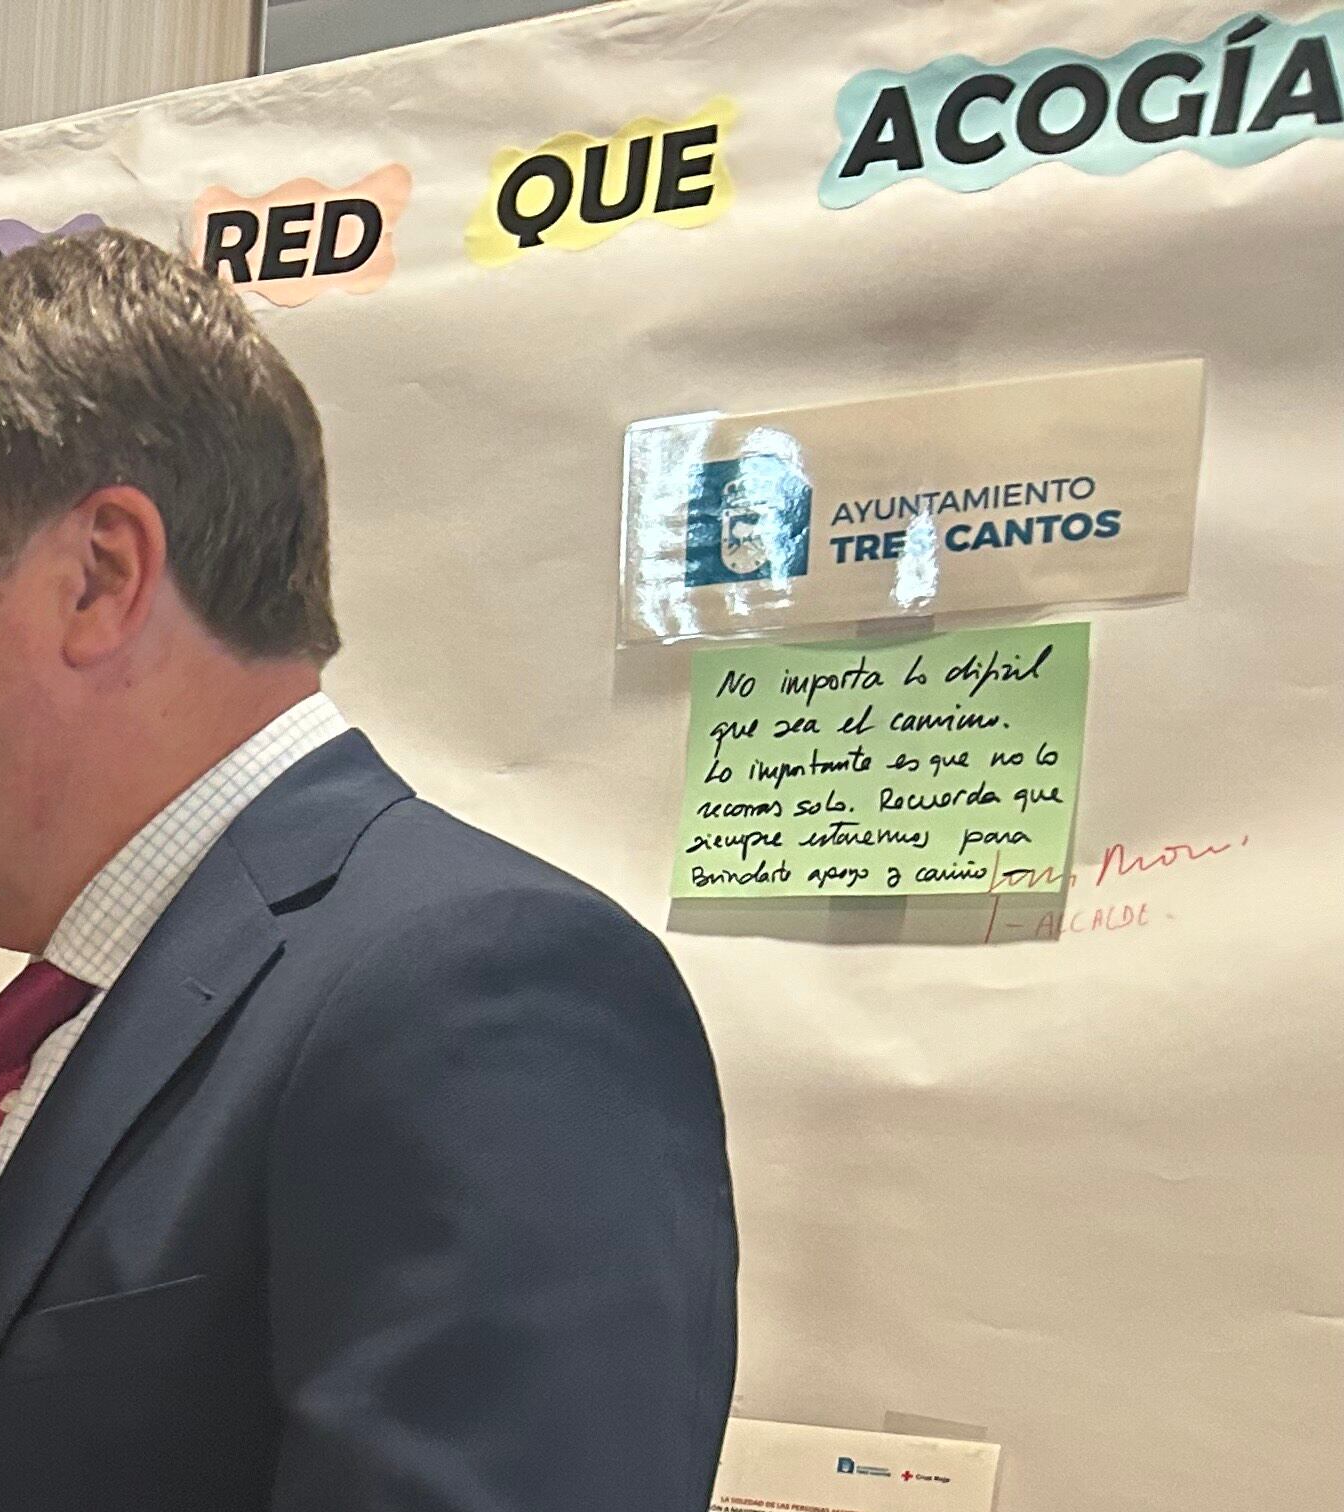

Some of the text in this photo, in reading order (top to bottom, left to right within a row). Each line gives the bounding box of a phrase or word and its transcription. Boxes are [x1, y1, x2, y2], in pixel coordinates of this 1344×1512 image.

[202, 198, 383, 284] RED
[497, 125, 718, 249] QUE
[839, 15, 1344, 178] ACOGÍA
[830, 476, 1096, 527] AYUNTAMIENTO
[829, 509, 1123, 564] TRE CANTOS
[715, 670, 756, 698] No
[780, 655, 885, 707] importa
[709, 703, 1010, 758] que sea el camino.
[749, 744, 872, 790] importante
[886, 752, 920, 772] es
[929, 751, 969, 777] que
[990, 751, 1024, 767] no
[1036, 742, 1059, 766] lo
[879, 781, 1001, 811] Recuerda
[1013, 787, 1064, 813] que
[685, 821, 1032, 861] siempre estaremos para
[807, 866, 870, 889] apoyo
